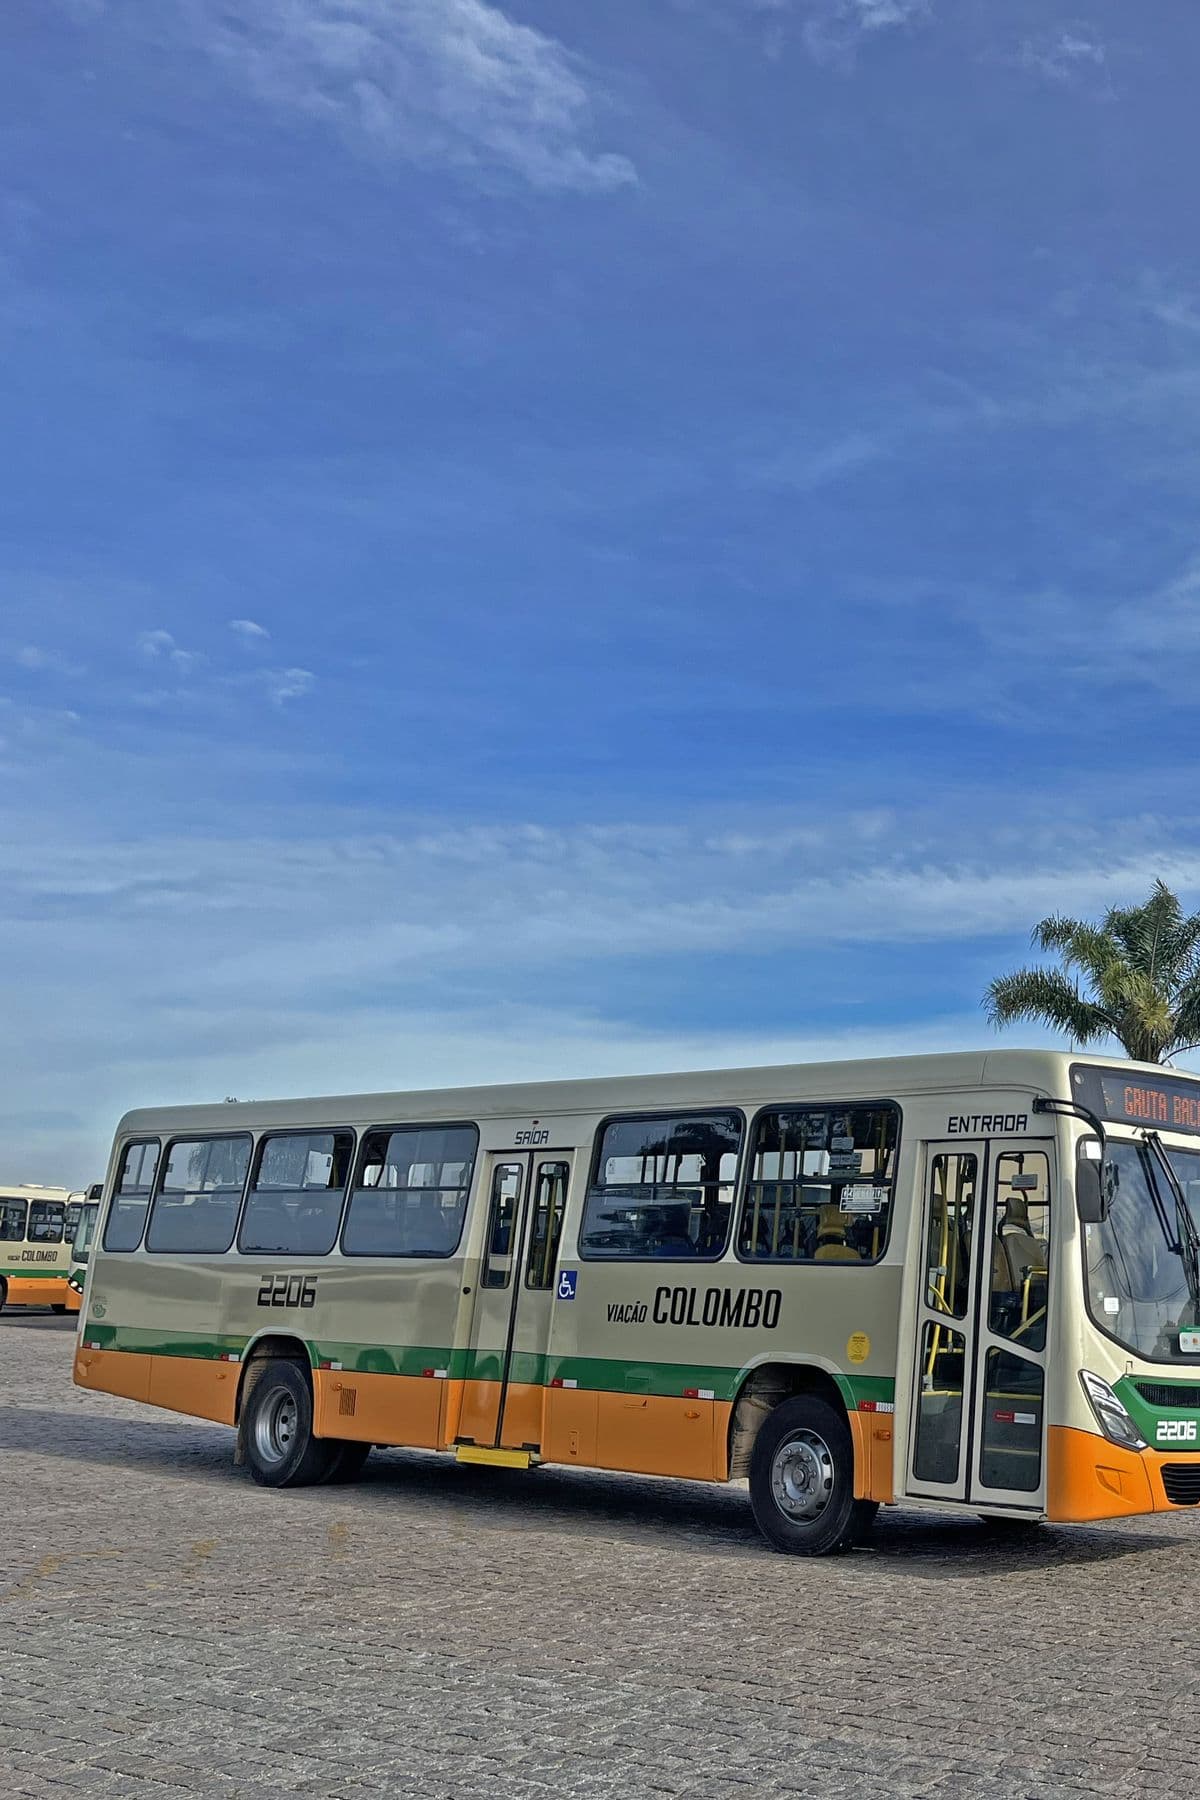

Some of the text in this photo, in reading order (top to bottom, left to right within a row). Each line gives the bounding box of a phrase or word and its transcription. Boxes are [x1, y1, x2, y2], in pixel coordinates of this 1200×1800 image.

[1123, 1086, 1168, 1122] GRUTA
[947, 1114, 1028, 1133] ENTRADA
[514, 1126, 549, 1145] SAÍDA
[21, 1250, 58, 1262] COLOMBO
[257, 1275, 318, 1308] 2206
[607, 1286, 782, 1329] VIAÇÃO COLOMBO
[1156, 1421, 1197, 1440] 2206
